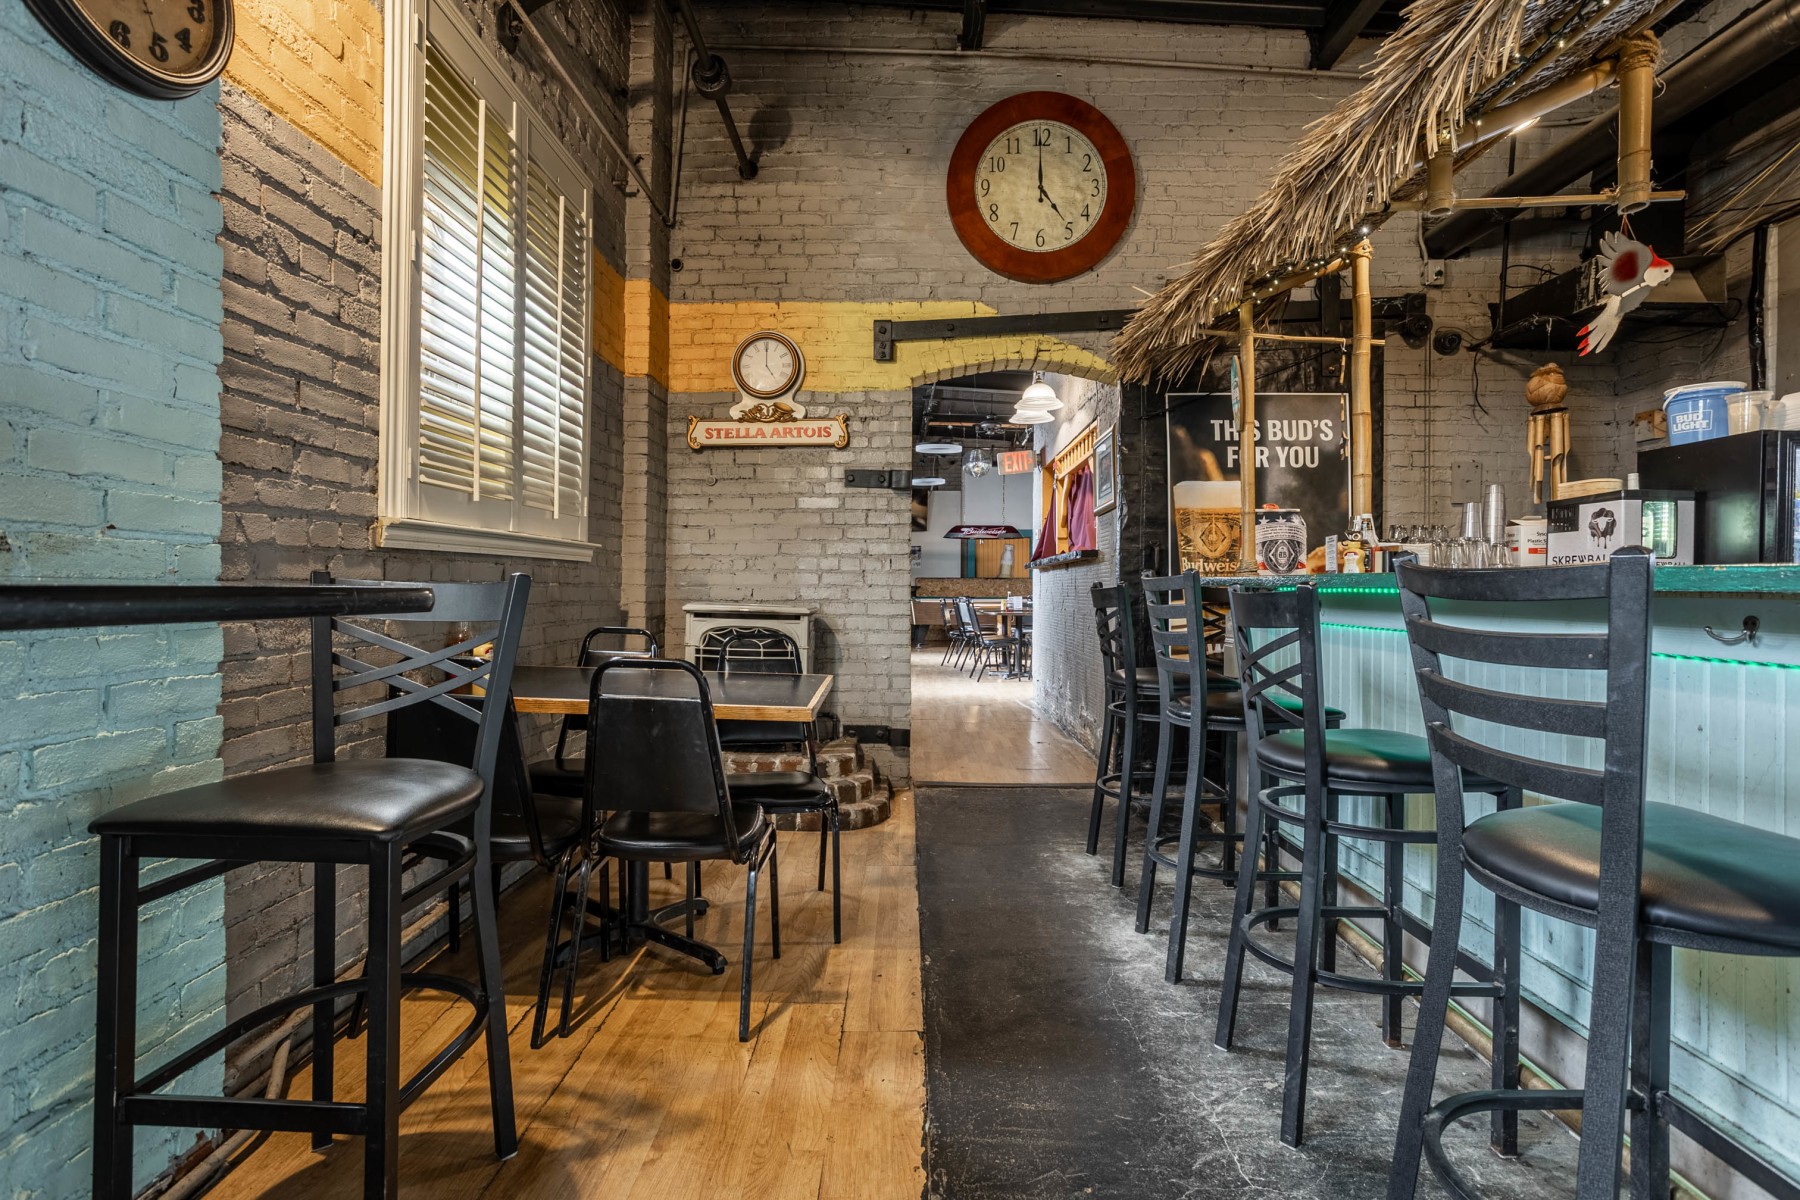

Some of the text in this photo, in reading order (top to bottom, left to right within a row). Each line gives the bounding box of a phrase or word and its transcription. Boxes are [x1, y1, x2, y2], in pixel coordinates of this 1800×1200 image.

[109, 20, 131, 49] 6
[174, 27, 193, 54] 4
[148, 31, 170, 62] 5
[1005, 138, 1021, 154] 11
[1032, 128, 1051, 146] 12
[1065, 136, 1073, 154] 1
[988, 157, 1005, 172] 10
[1082, 154, 1092, 172] 2
[980, 179, 990, 197] 9
[1091, 179, 1100, 197] 3
[989, 204, 999, 222] 8
[1080, 203, 1090, 221] 4
[1010, 222, 1019, 241] 7
[1035, 229, 1045, 247] 6
[1064, 222, 1073, 240] 5
[1673, 420, 1709, 432] LIGHT
[1676, 412, 1702, 423] BUD
[704, 426, 832, 439] STELLA ARTOIS
[1210, 419, 1334, 441] THS BUD'S
[1004, 452, 1029, 472] EXIT
[1227, 446, 1319, 468] FR YOU
[964, 526, 1006, 535] Budweiser
[1181, 557, 1241, 573] Budweis
